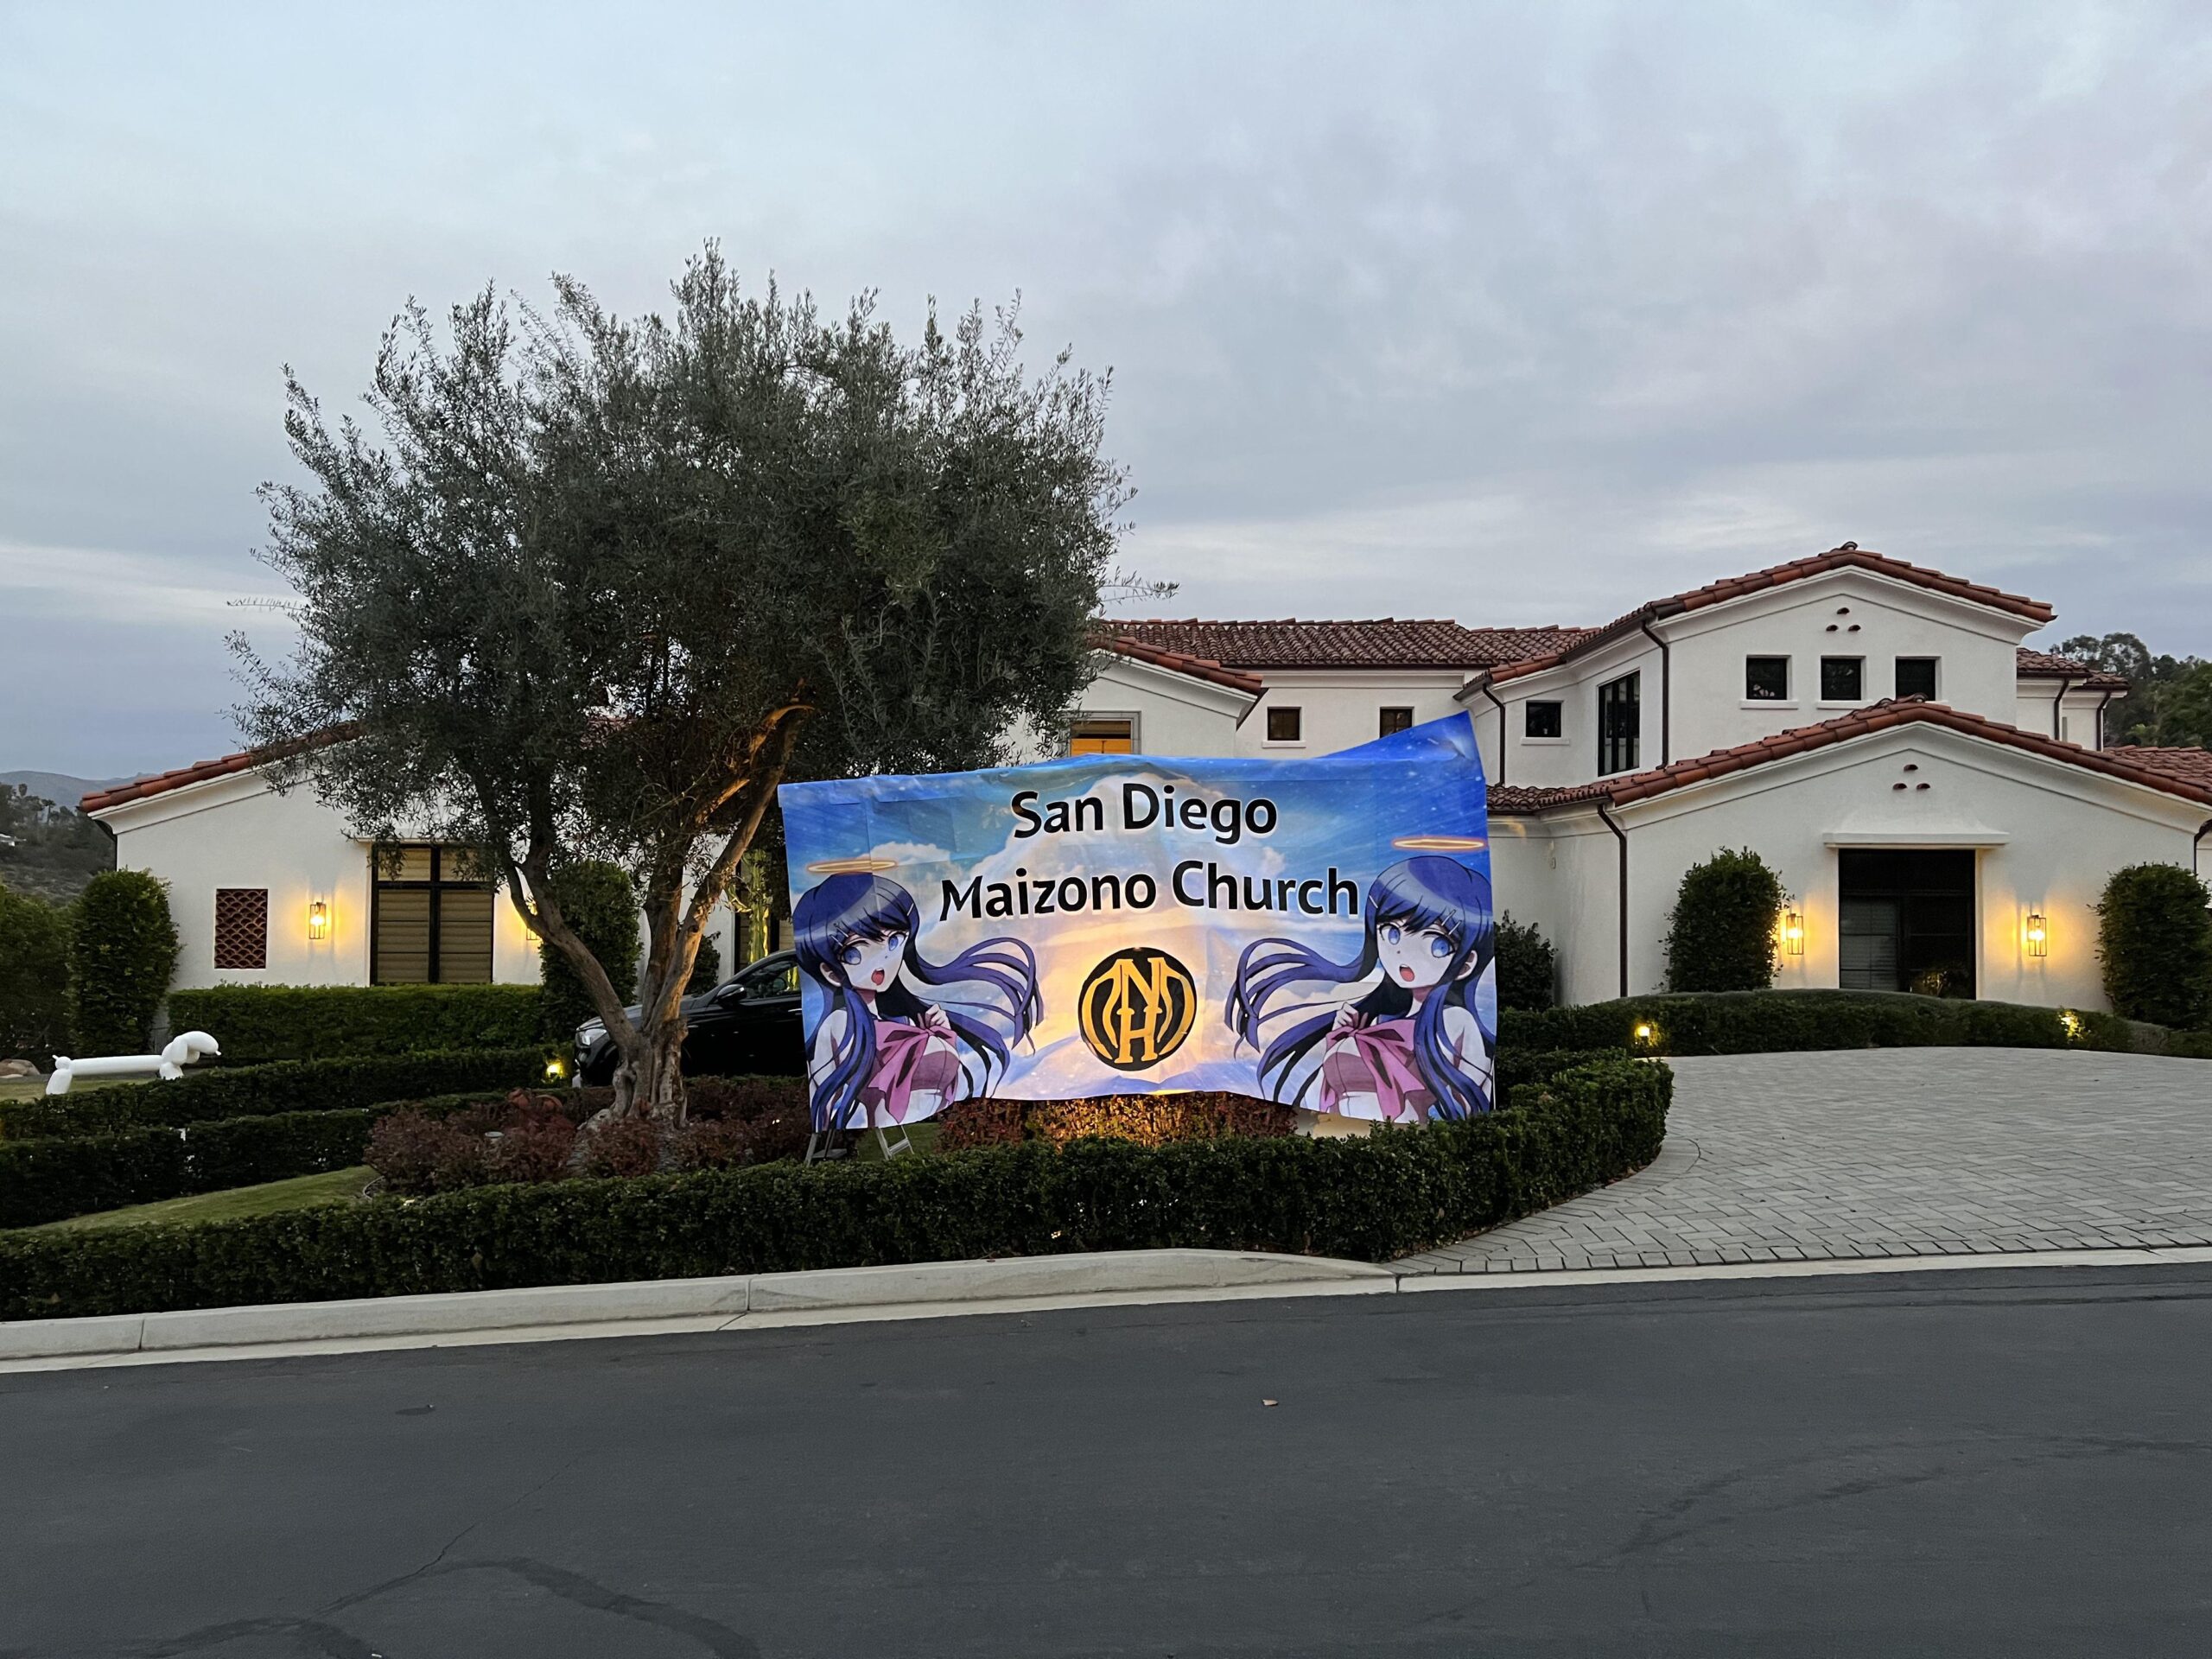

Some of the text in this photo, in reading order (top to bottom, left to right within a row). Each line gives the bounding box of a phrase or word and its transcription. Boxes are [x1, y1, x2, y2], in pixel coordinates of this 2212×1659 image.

[1011, 783, 1277, 845] San Diego
[939, 860, 1358, 922] Maizono Church
